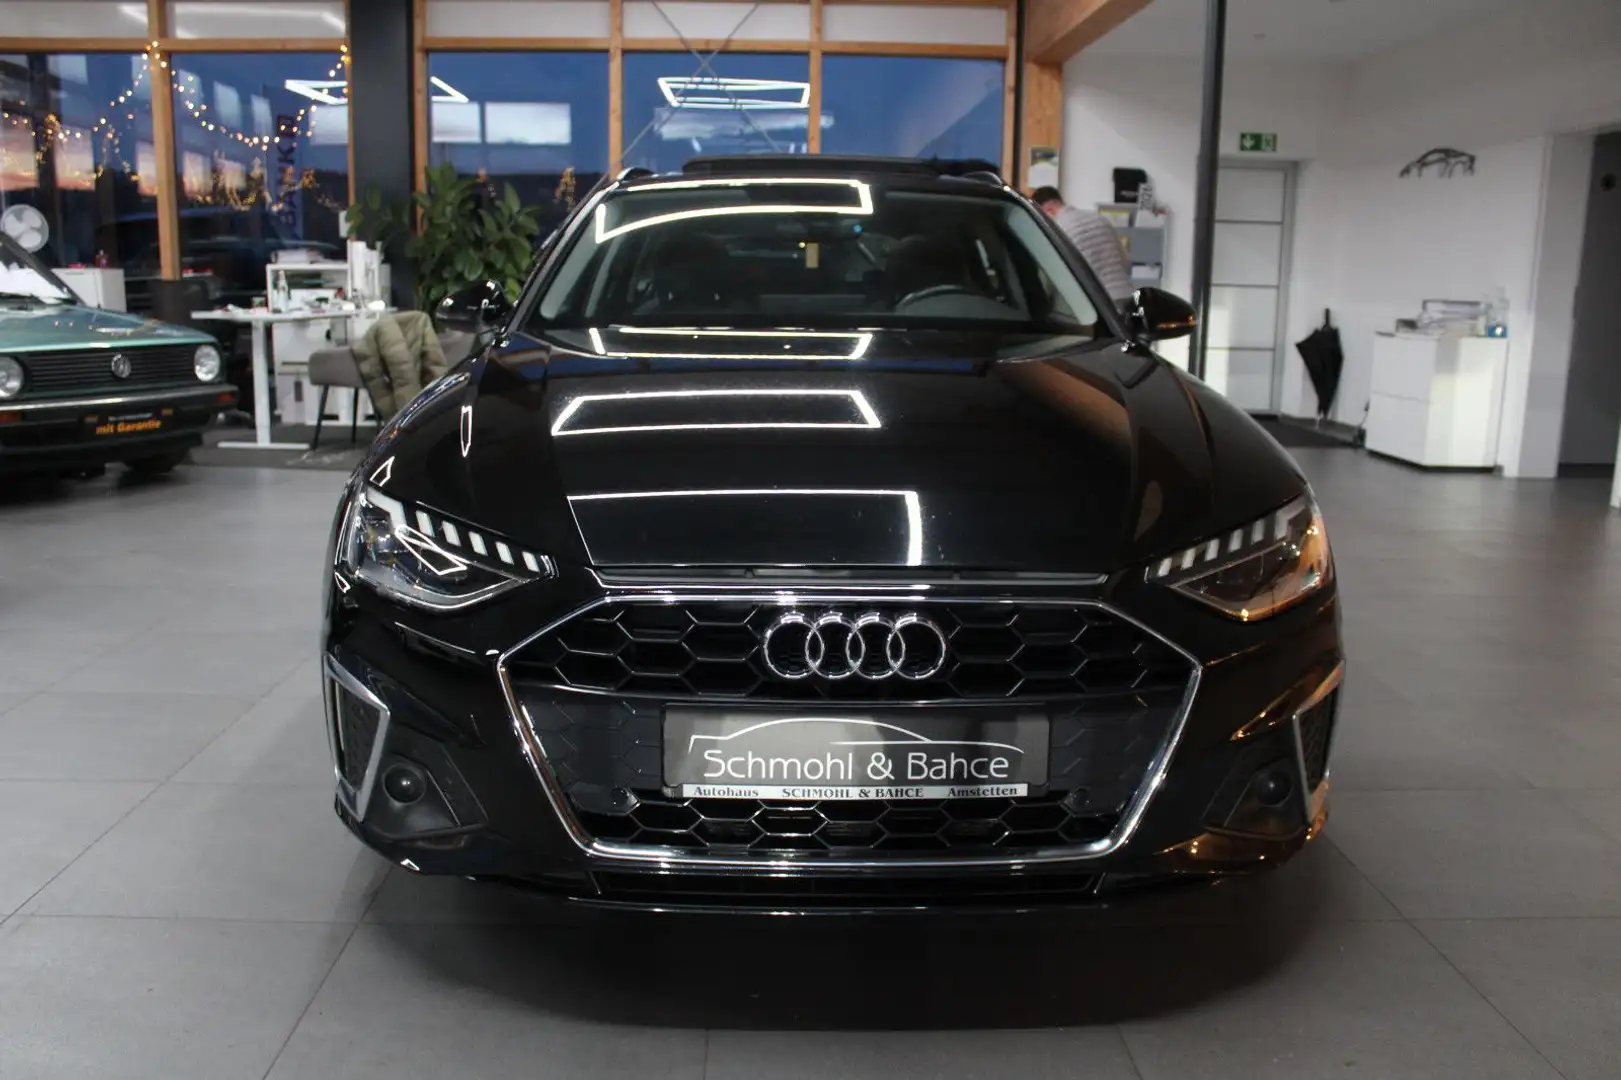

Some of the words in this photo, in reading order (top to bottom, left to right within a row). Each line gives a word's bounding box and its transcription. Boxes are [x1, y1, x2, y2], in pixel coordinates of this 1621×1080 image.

[703, 749, 853, 780] Schmohl
[866, 751, 896, 781] &
[906, 751, 1010, 781] Bahce
[693, 785, 760, 798] Autohaus
[781, 787, 854, 799] SCHMOHL
[858, 787, 871, 799] &
[874, 787, 925, 799] BAHCE
[947, 785, 1018, 798] Amstetten
